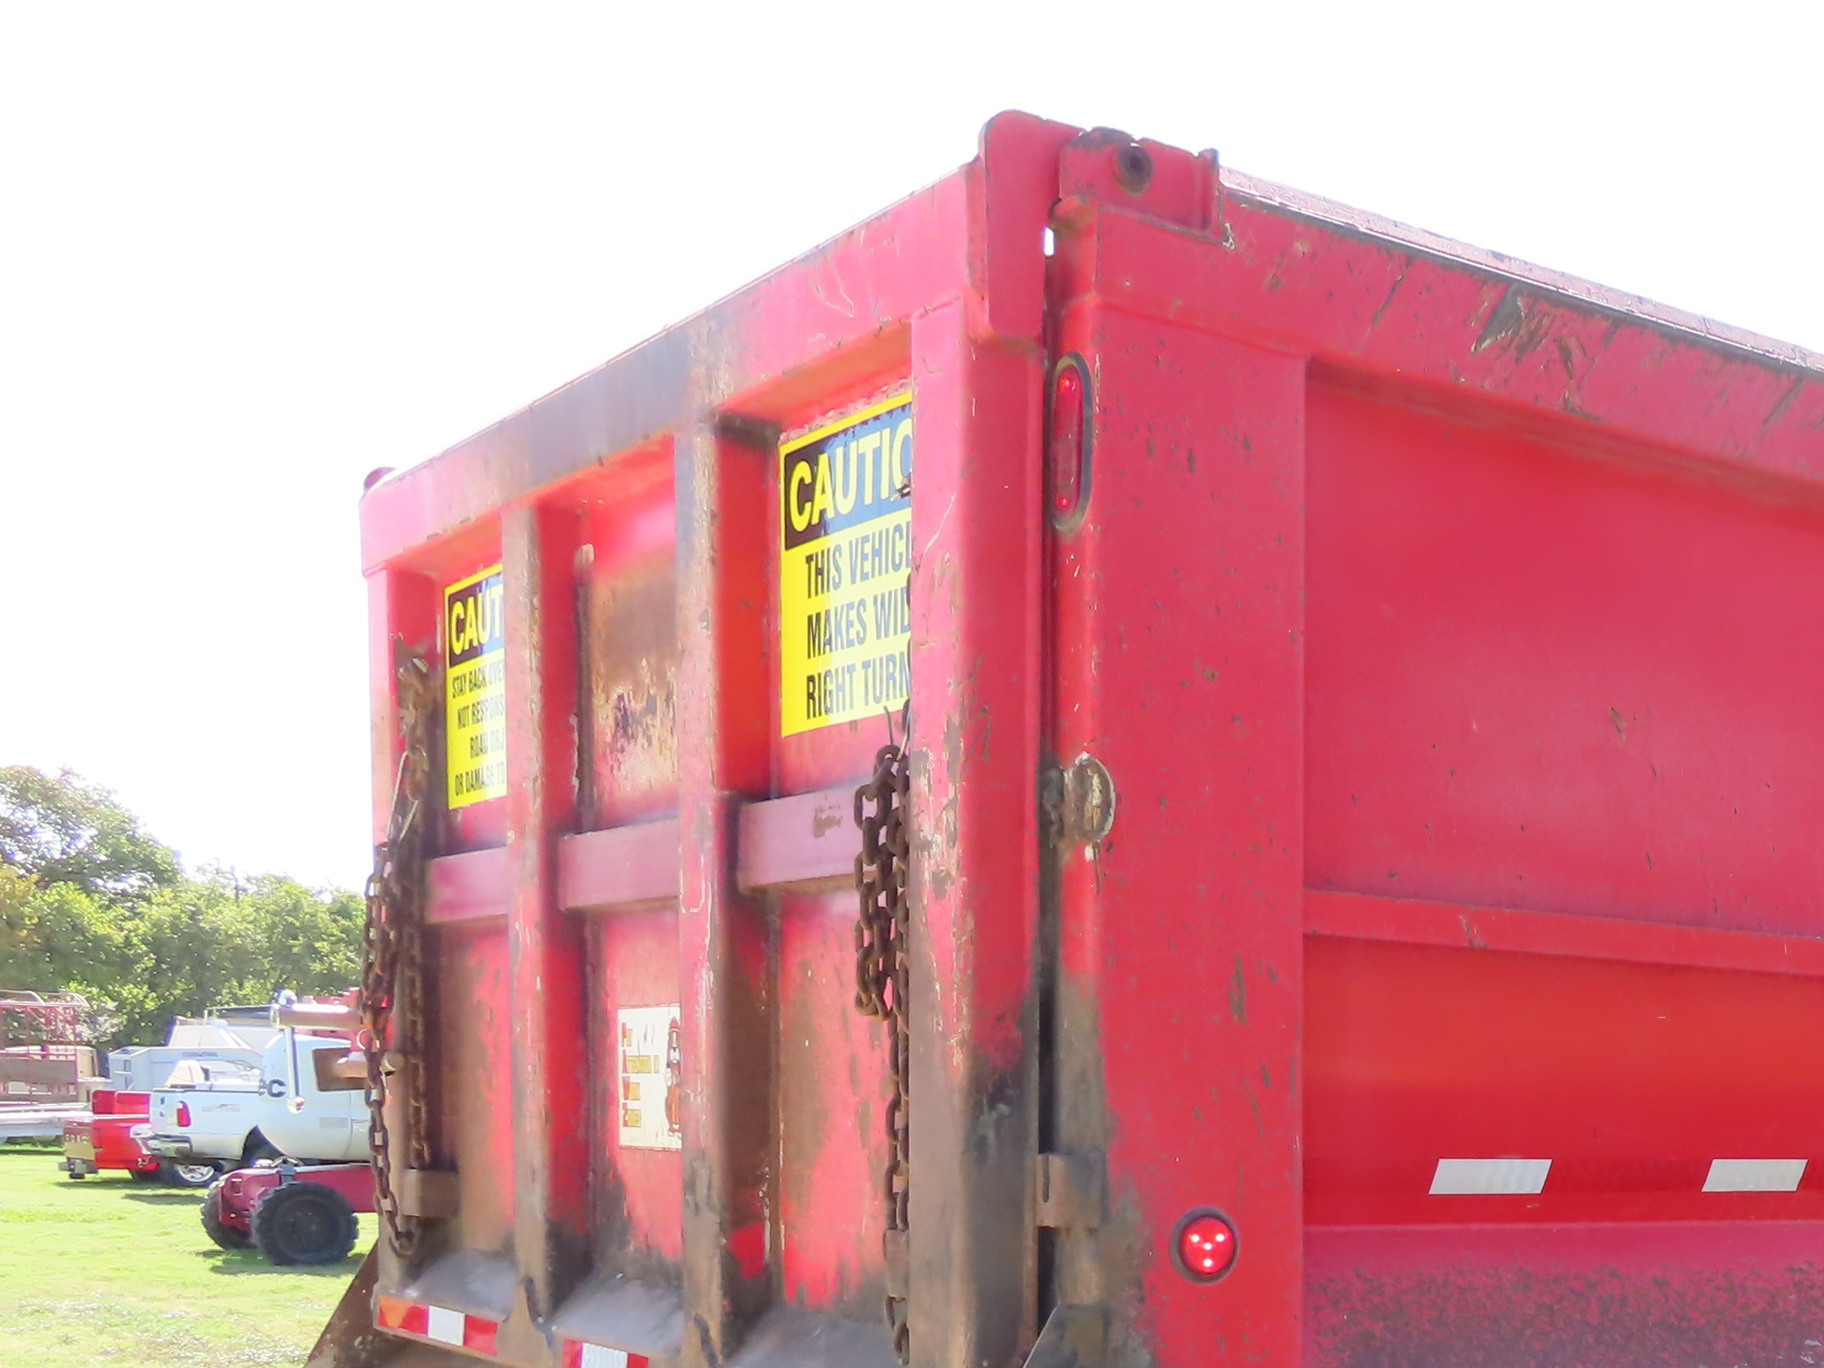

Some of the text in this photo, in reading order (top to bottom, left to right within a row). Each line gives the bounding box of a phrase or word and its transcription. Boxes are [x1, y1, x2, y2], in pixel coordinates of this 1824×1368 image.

[805, 543, 843, 600] THIS
[807, 597, 868, 660] MAKES
[452, 672, 467, 699] STAY
[469, 664, 487, 693] BACK
[806, 663, 857, 721] RIGHT
[457, 704, 470, 730] NOT
[470, 732, 488, 759] ROAD
[455, 772, 464, 797] OR
[465, 763, 494, 794] DAMAGE
